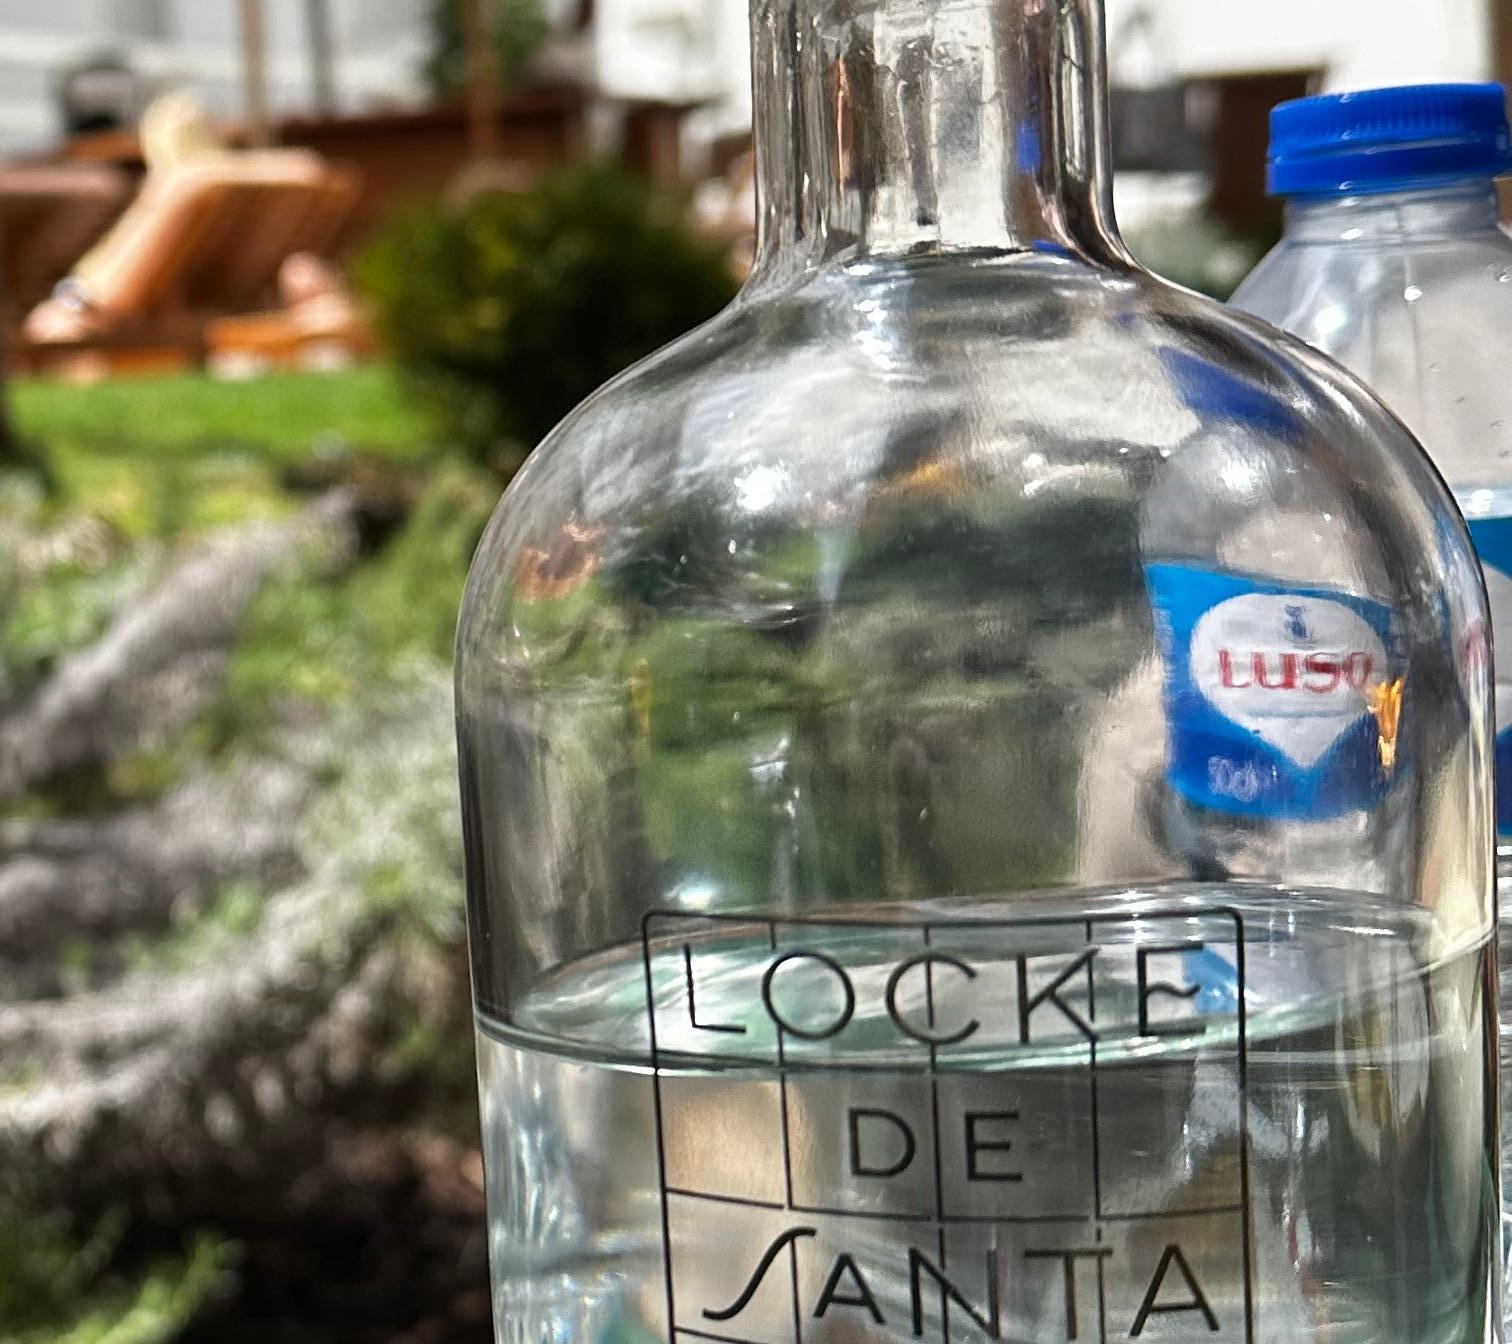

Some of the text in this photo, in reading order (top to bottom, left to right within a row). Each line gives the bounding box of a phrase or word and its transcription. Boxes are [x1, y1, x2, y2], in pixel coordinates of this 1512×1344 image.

[1217, 650, 1374, 693] LUSO
[682, 943, 1207, 1044] LOCKE
[848, 1108, 1023, 1182] DE
[702, 1226, 1219, 1340] SANTA
